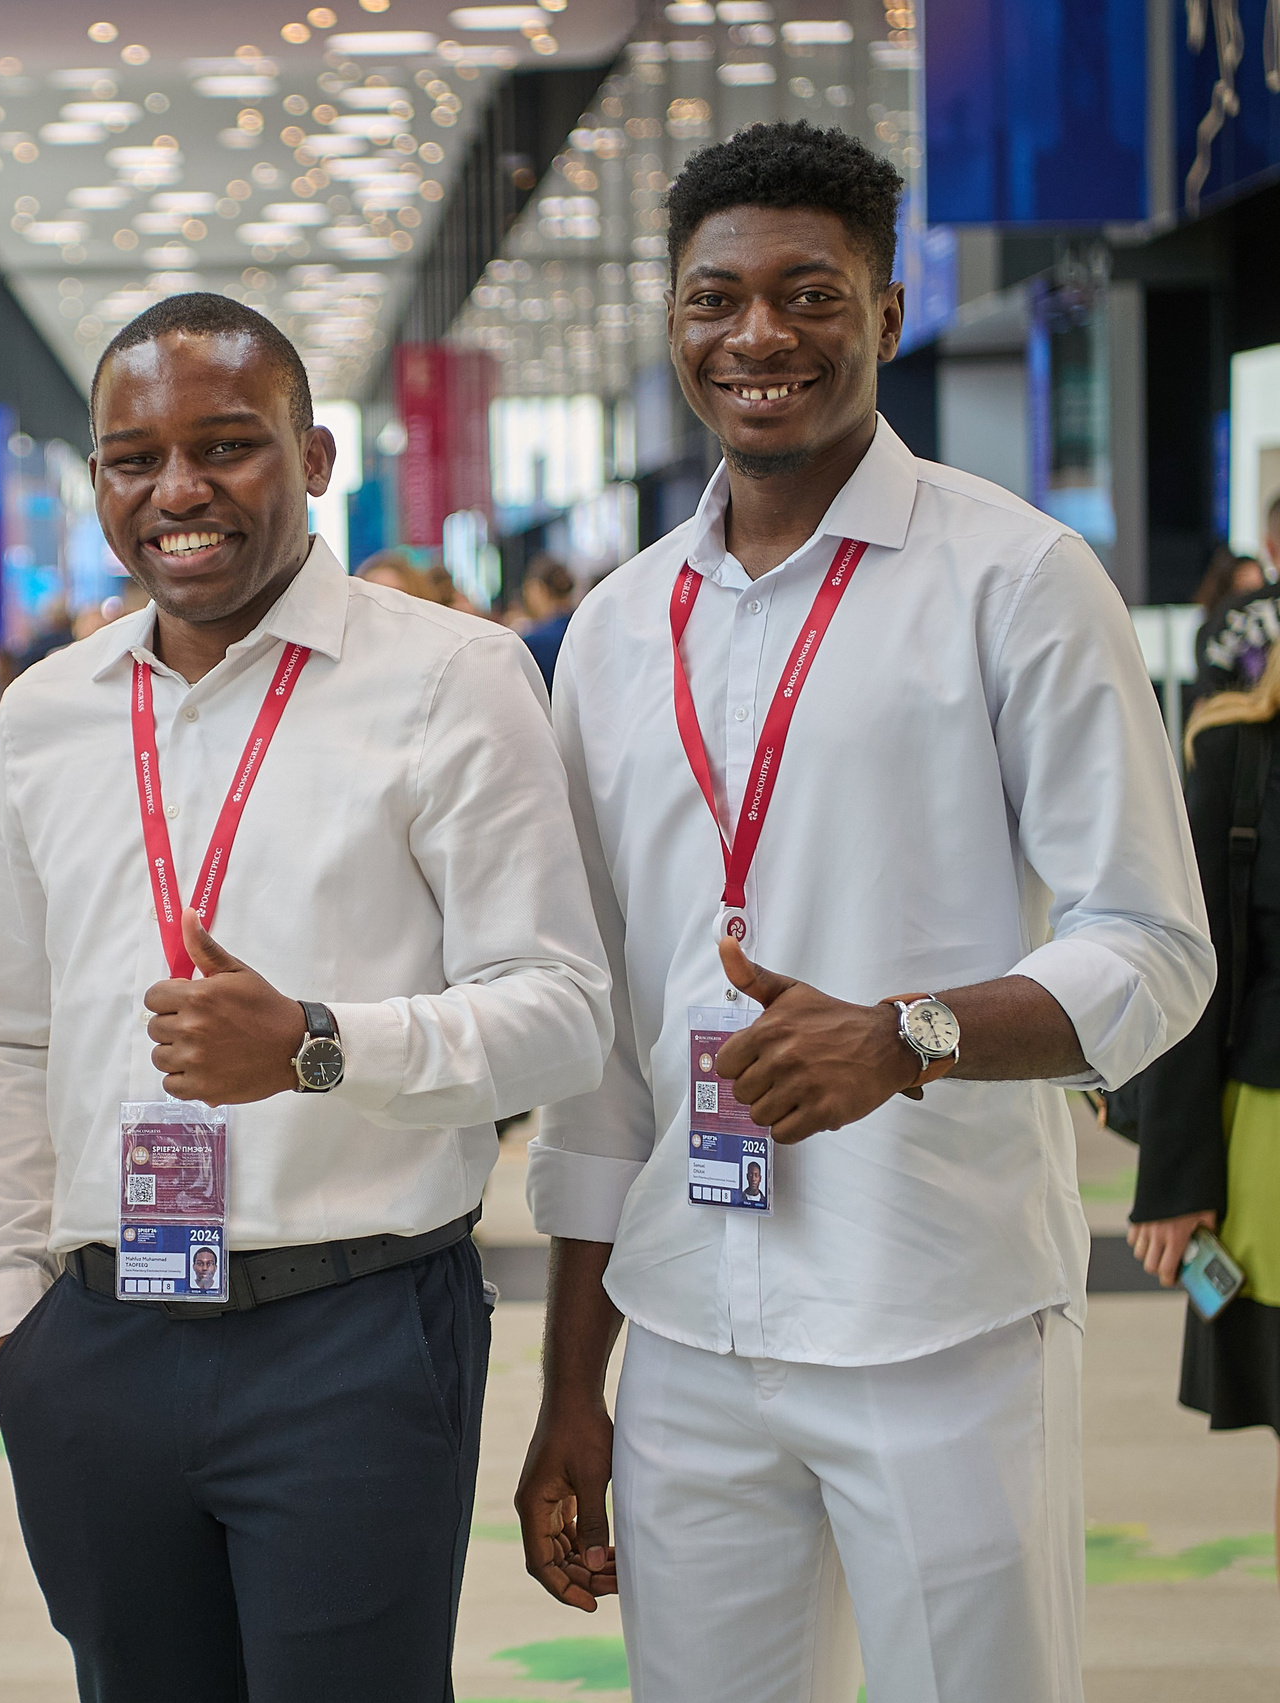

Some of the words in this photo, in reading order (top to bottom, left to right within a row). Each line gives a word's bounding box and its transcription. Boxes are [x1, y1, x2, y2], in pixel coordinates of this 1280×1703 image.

[680, 568, 696, 605] ONGRESS
[787, 629, 817, 688] ROSCONGRESS
[142, 760, 156, 816] РОСКОНГРЕСС
[236, 737, 264, 794] ROSCONGRESS
[751, 746, 774, 812] РОСКОНГРЕСС
[157, 867, 174, 923] ROSCONGRESS
[200, 847, 223, 909] РОСКОНГРЕСС
[742, 1140, 766, 1154] 2024
[189, 1229, 220, 1242] 2024
